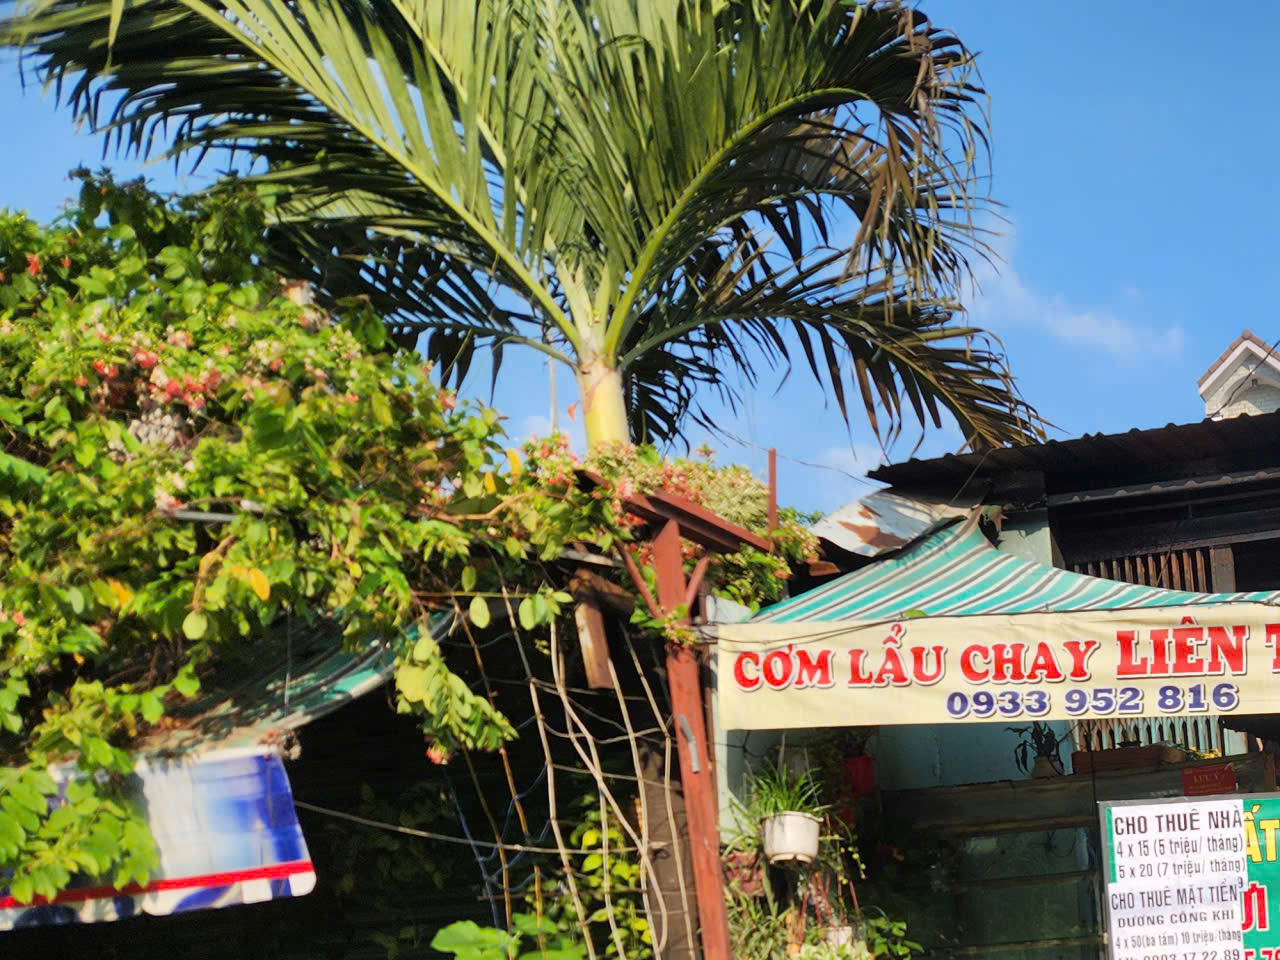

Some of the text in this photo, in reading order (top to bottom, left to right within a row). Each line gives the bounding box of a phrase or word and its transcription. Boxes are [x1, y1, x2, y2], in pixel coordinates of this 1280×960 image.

[733, 643, 834, 690] CƠM
[847, 624, 946, 687] LẨU
[960, 640, 1100, 684] CHAY
[1116, 616, 1249, 678] LIÊN
[946, 683, 1239, 719] 0933 952 816
[1115, 805, 1243, 835] CHO THUÊ NHÀ
[1244, 804, 1280, 863] ẤT
[1117, 841, 1123, 857] 4
[1138, 840, 1149, 856] 15
[1119, 866, 1125, 878] 5
[1140, 864, 1153, 877] 20
[1111, 892, 1135, 910] CHO
[1139, 886, 1172, 909] THUÊ
